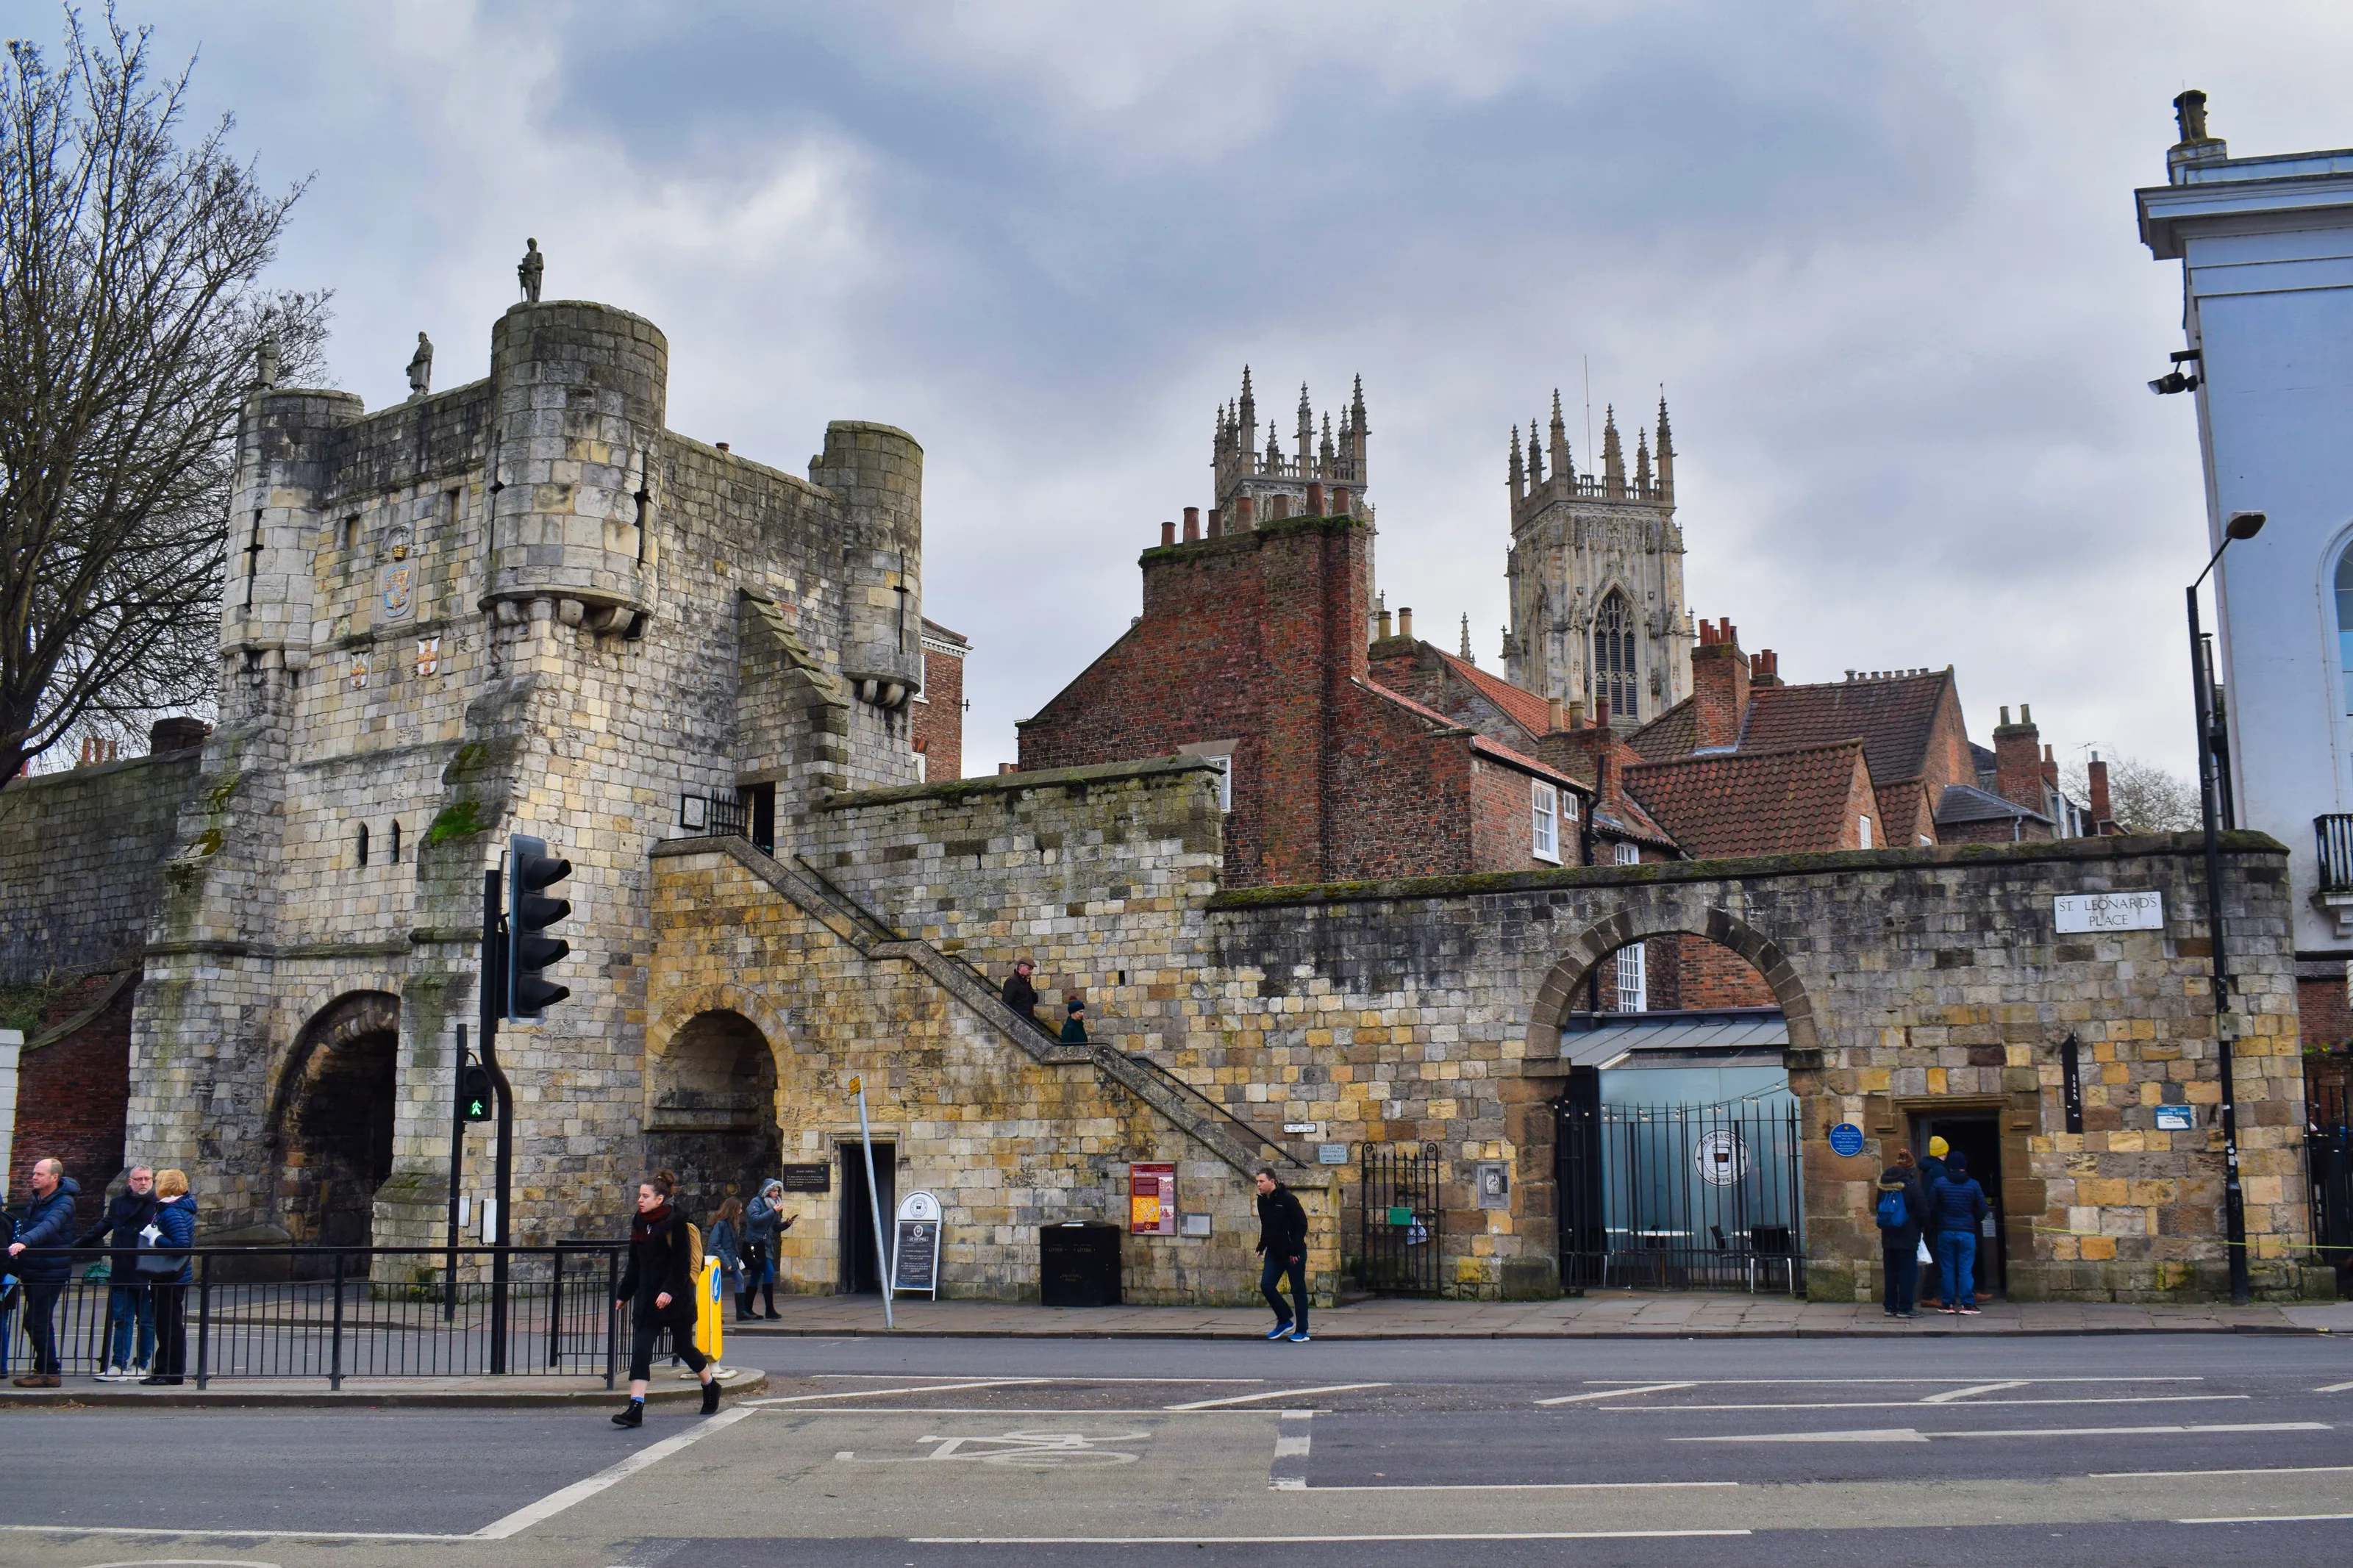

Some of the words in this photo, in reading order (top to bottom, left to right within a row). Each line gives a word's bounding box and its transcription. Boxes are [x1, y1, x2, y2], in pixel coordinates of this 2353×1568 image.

[2059, 901, 2074, 912] ST.
[2084, 897, 2157, 911] LEONARD'S
[2089, 914, 2129, 926] PLACE
